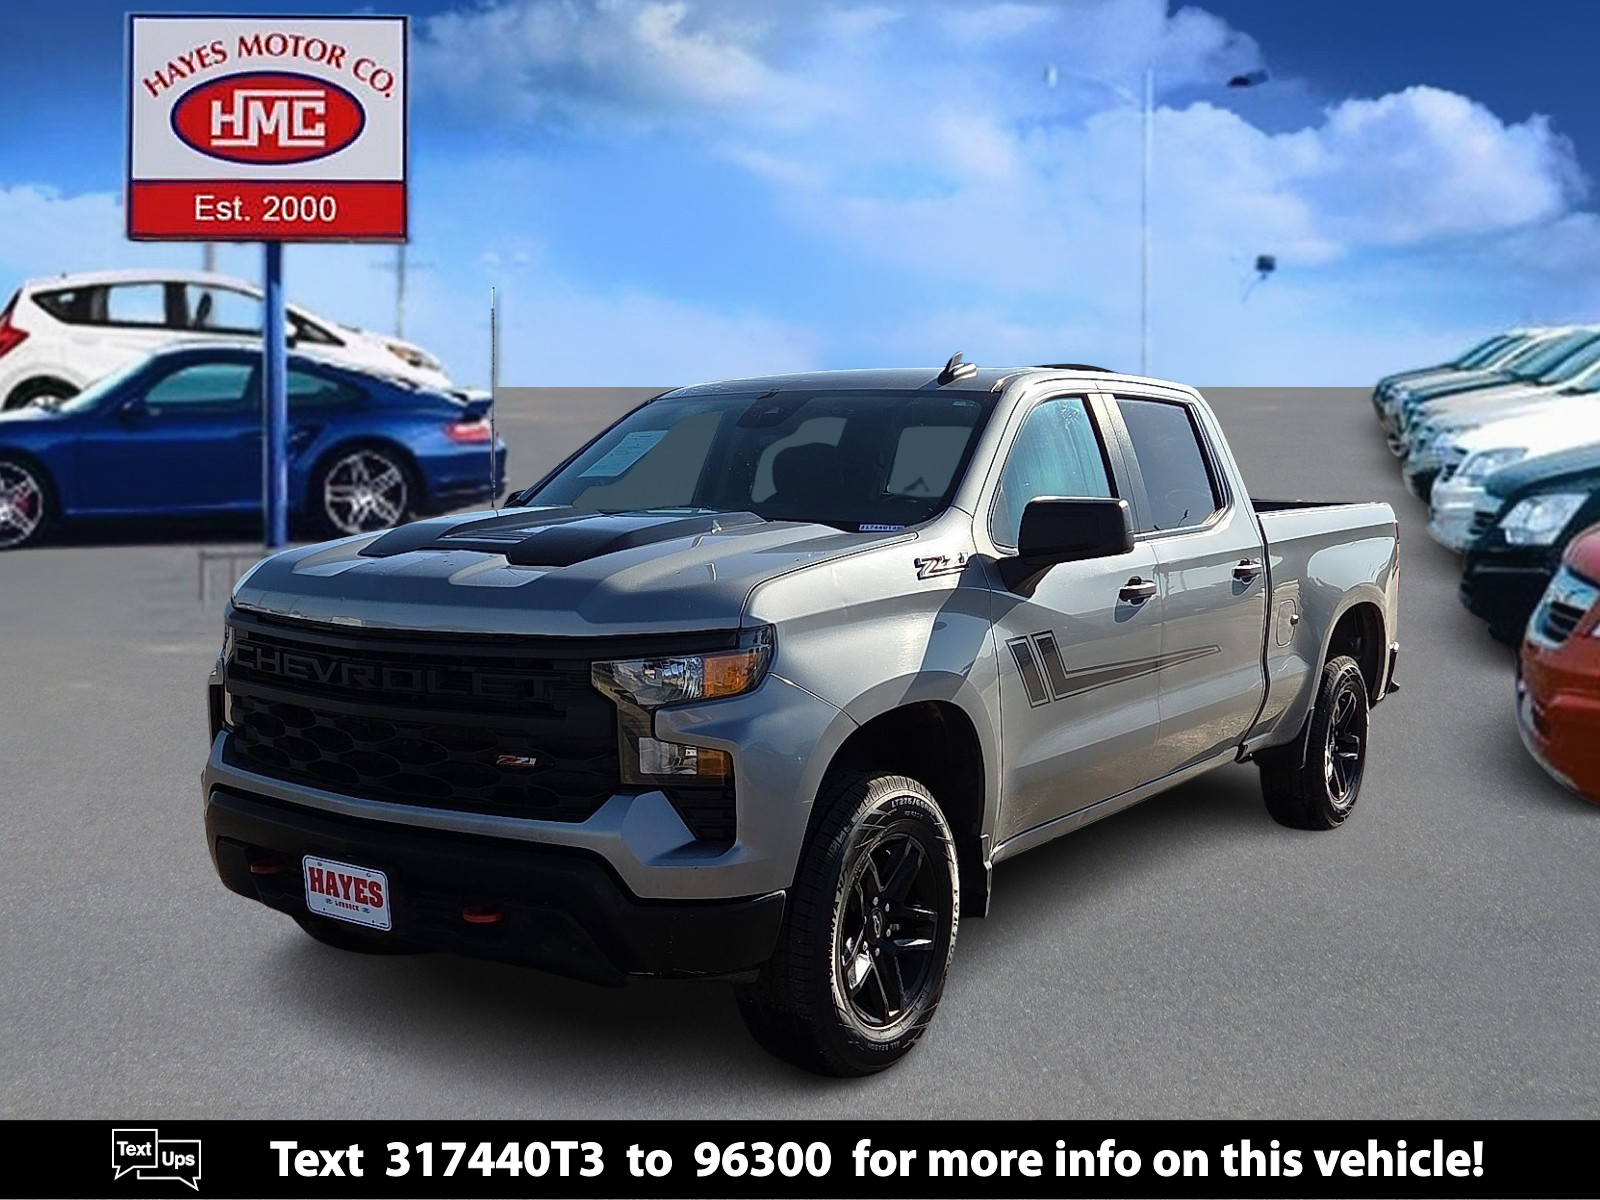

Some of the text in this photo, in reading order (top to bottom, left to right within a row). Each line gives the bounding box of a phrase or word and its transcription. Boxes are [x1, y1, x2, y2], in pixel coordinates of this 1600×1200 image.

[143, 33, 395, 98] HAYES MOTOR CO.
[210, 89, 325, 147] HMC
[195, 195, 337, 222] Est. 2000
[233, 643, 564, 698] CHEVROLET
[308, 866, 384, 909] HAYES
